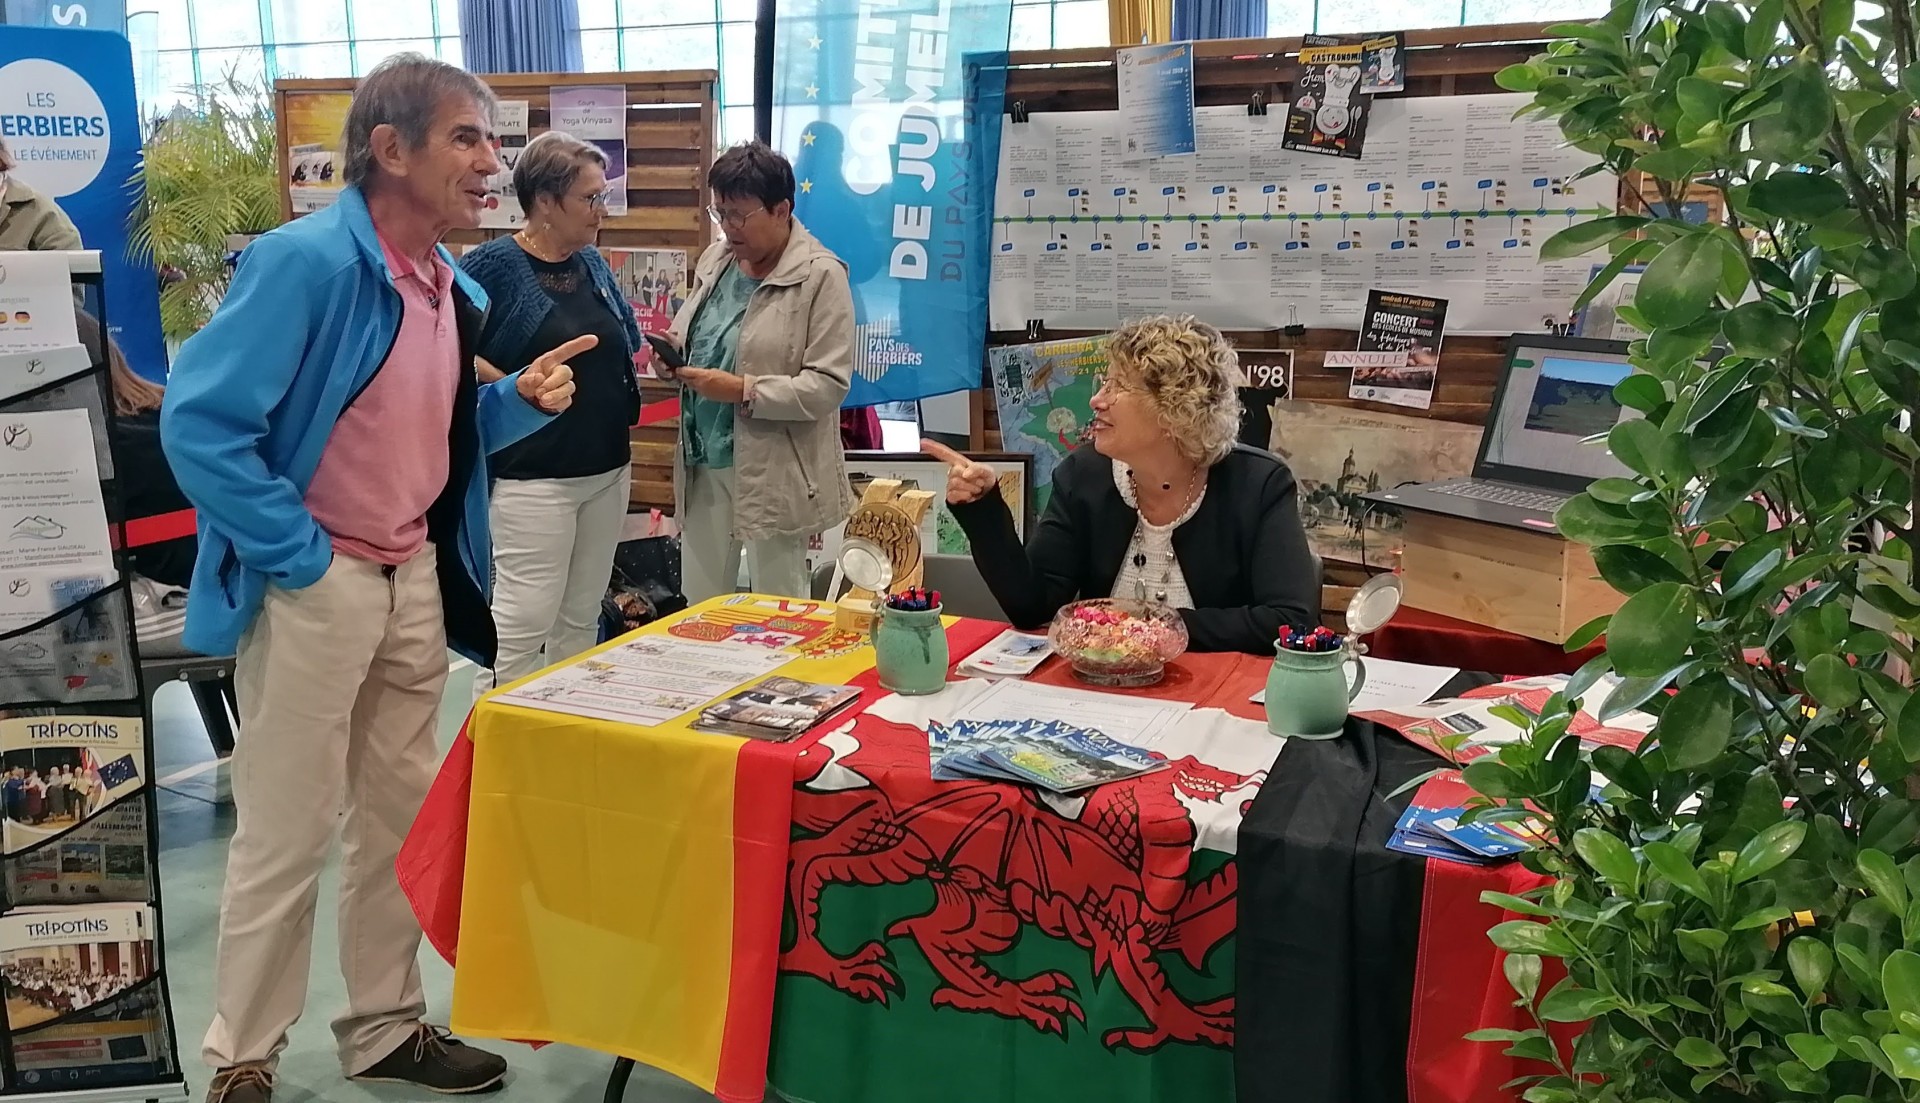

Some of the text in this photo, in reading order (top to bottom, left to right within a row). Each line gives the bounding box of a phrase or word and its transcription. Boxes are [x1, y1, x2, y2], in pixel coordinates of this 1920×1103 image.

[27, 92, 56, 108] LES
[562, 117, 613, 126] Yoga Vinyasa
[31, 146, 97, 161] ÉVÉNEMENT
[946, 141, 974, 225] PAYS
[889, 204, 932, 280] DE
[940, 241, 966, 282] DU
[1373, 311, 1419, 328] CONCERT
[868, 337, 895, 352] PAYS
[1035, 341, 1094, 357] CARRERA
